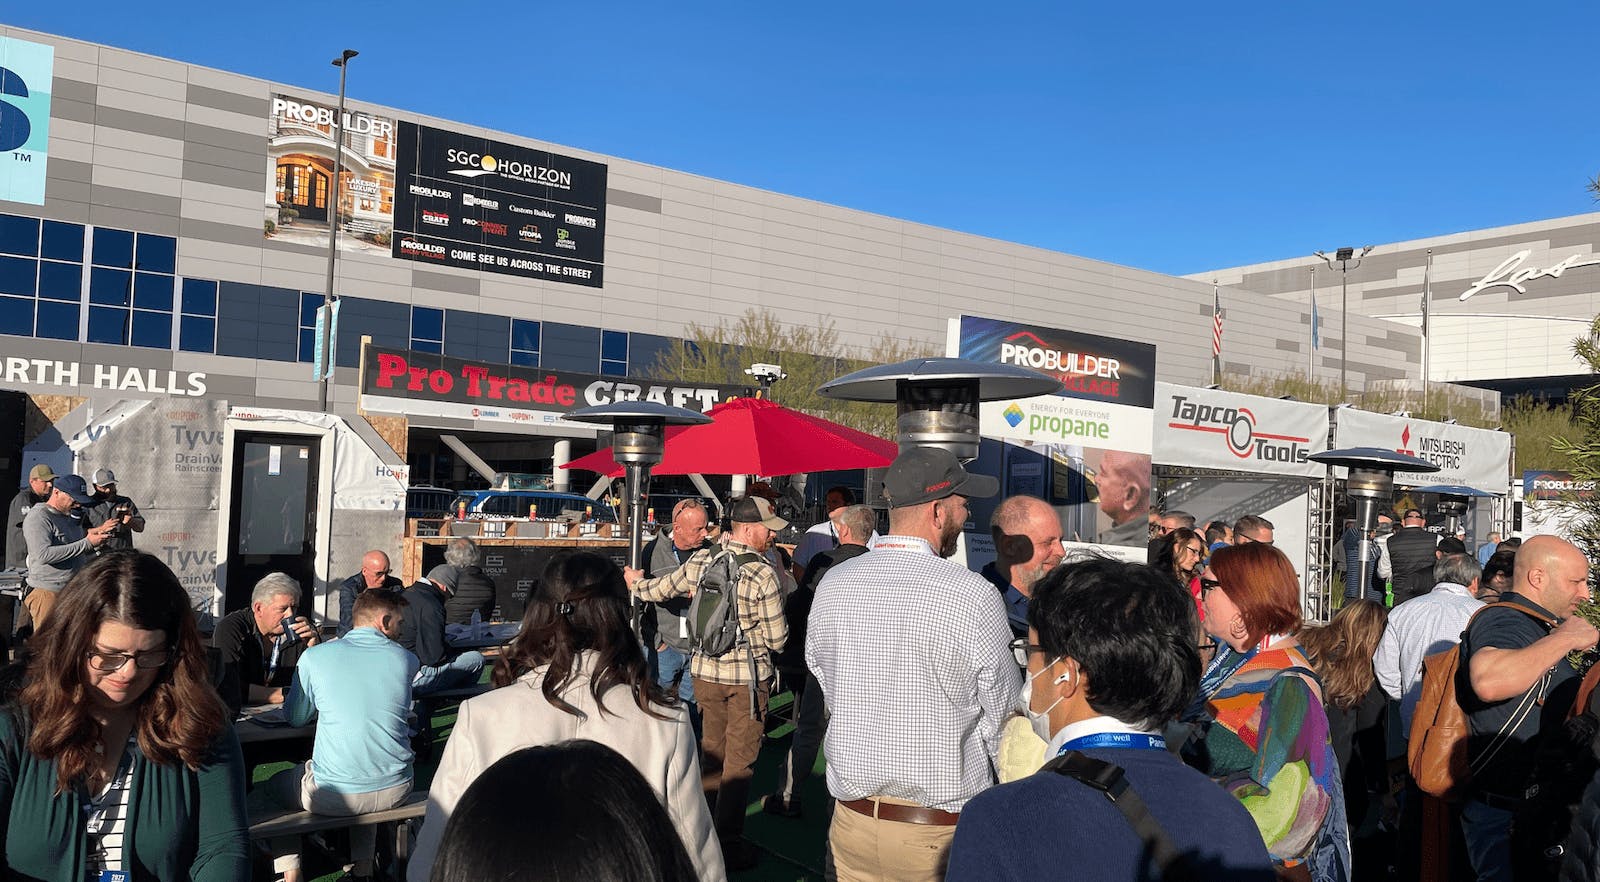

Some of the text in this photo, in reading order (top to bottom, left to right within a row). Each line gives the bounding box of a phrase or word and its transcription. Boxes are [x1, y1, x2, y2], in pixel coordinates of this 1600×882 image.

[272, 98, 394, 139] PROBUILDER
[13, 152, 31, 162] TM
[446, 149, 572, 186] SGC HORIZON
[349, 184, 377, 194] LUXURY
[409, 184, 452, 200] PROBUILDER
[422, 214, 449, 225] CRAFT
[509, 204, 534, 216] Custom
[533, 208, 556, 219] Builder
[564, 213, 597, 228] PRODUCTS
[518, 229, 542, 240] UTOPIA
[400, 239, 446, 255] PROBUILDER
[421, 251, 446, 260] VILLAGE
[450, 249, 593, 279] COME SEE US ACROSS THE STREET
[1001, 343, 1120, 380] PROBUILDER
[0, 357, 207, 397] RTH HALLS
[376, 353, 720, 413] Pro Trade CRAFT
[1030, 402, 1110, 421] ENERGY FOR EVERYONE
[1171, 395, 1238, 426] Tapco
[1029, 414, 1109, 439] propane
[1255, 438, 1310, 464] Tools
[1419, 436, 1466, 456] MITSUBISHI
[1419, 452, 1460, 470] ELECTRIC
[1430, 475, 1466, 485] CONDITIONING
[1113, 734, 1131, 743] well
